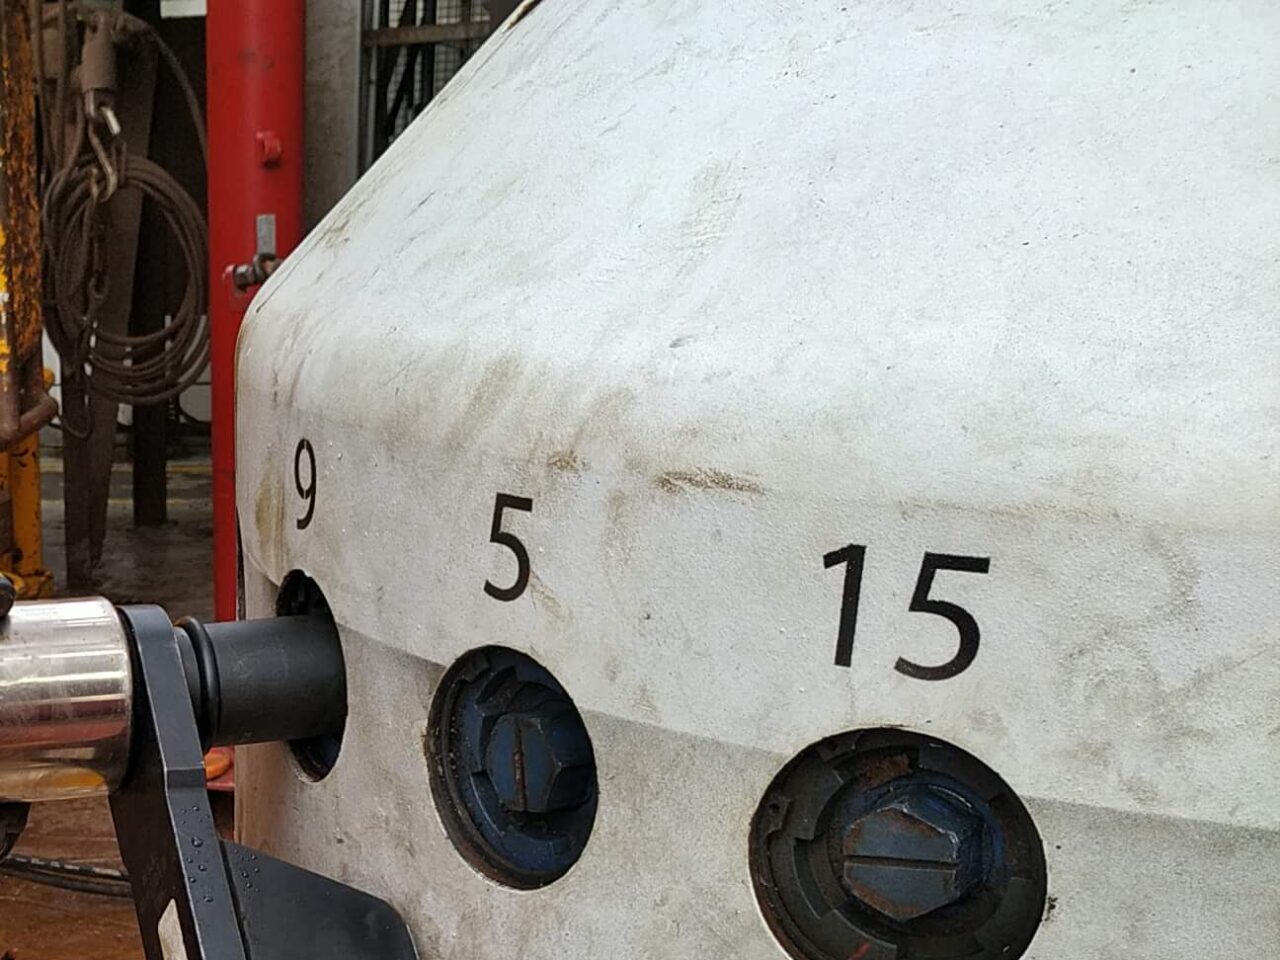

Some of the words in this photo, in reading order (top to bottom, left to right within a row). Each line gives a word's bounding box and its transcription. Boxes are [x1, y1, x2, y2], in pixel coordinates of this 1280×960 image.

[293, 438, 317, 530] 9
[483, 492, 533, 601] 5
[823, 543, 991, 681] 15
